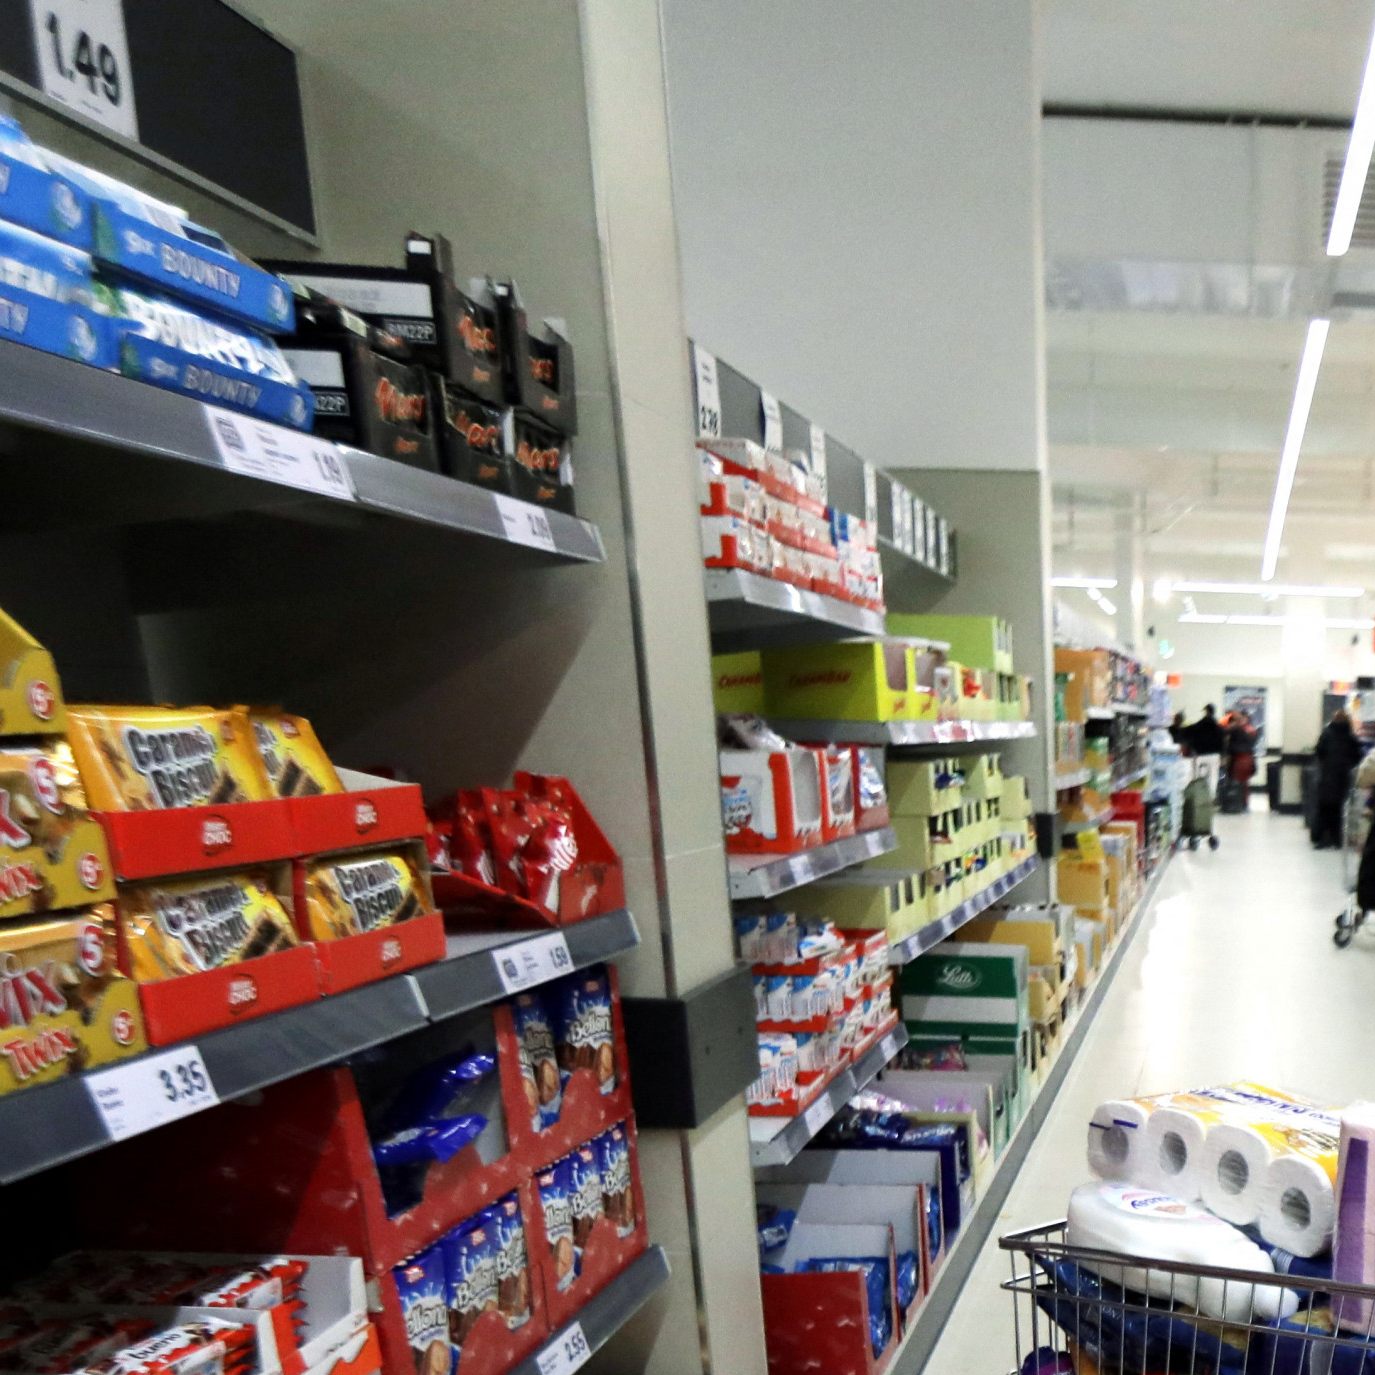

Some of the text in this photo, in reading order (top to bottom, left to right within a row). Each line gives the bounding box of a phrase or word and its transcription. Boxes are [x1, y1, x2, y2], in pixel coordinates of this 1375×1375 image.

[46, 11, 121, 107] 1.49
[159, 241, 241, 299] BOUNTY
[182, 362, 263, 409] BOUNTY
[160, 1060, 206, 1103] 3.35
[126, 1332, 183, 1361] bueno
